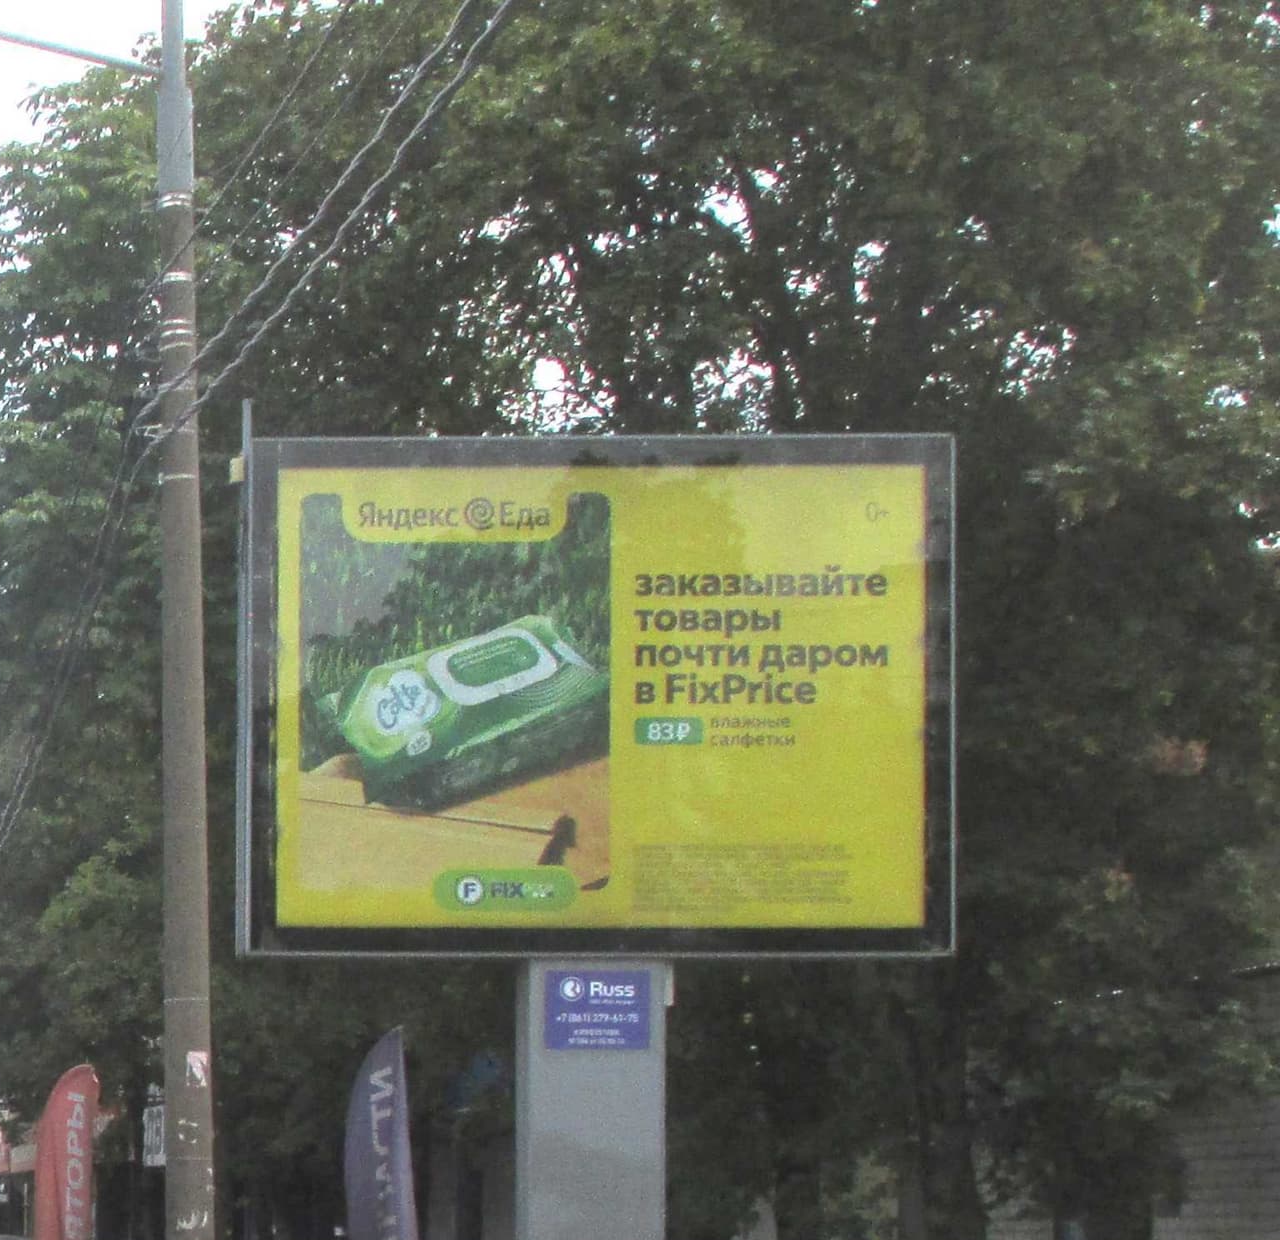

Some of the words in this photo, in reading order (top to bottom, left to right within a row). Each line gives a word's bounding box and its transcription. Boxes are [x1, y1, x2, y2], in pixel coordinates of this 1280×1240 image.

[358, 501, 459, 531] Яндекс
[499, 502, 551, 531] Еда
[634, 565, 888, 597] заказывайте
[634, 609, 782, 638] товары
[634, 644, 750, 667] почти
[758, 644, 889, 674] даром
[635, 681, 656, 704] в
[664, 672, 818, 705] FixPrice
[710, 716, 792, 730] влажные
[710, 733, 796, 748] салфетки
[589, 981, 636, 997] Russ
